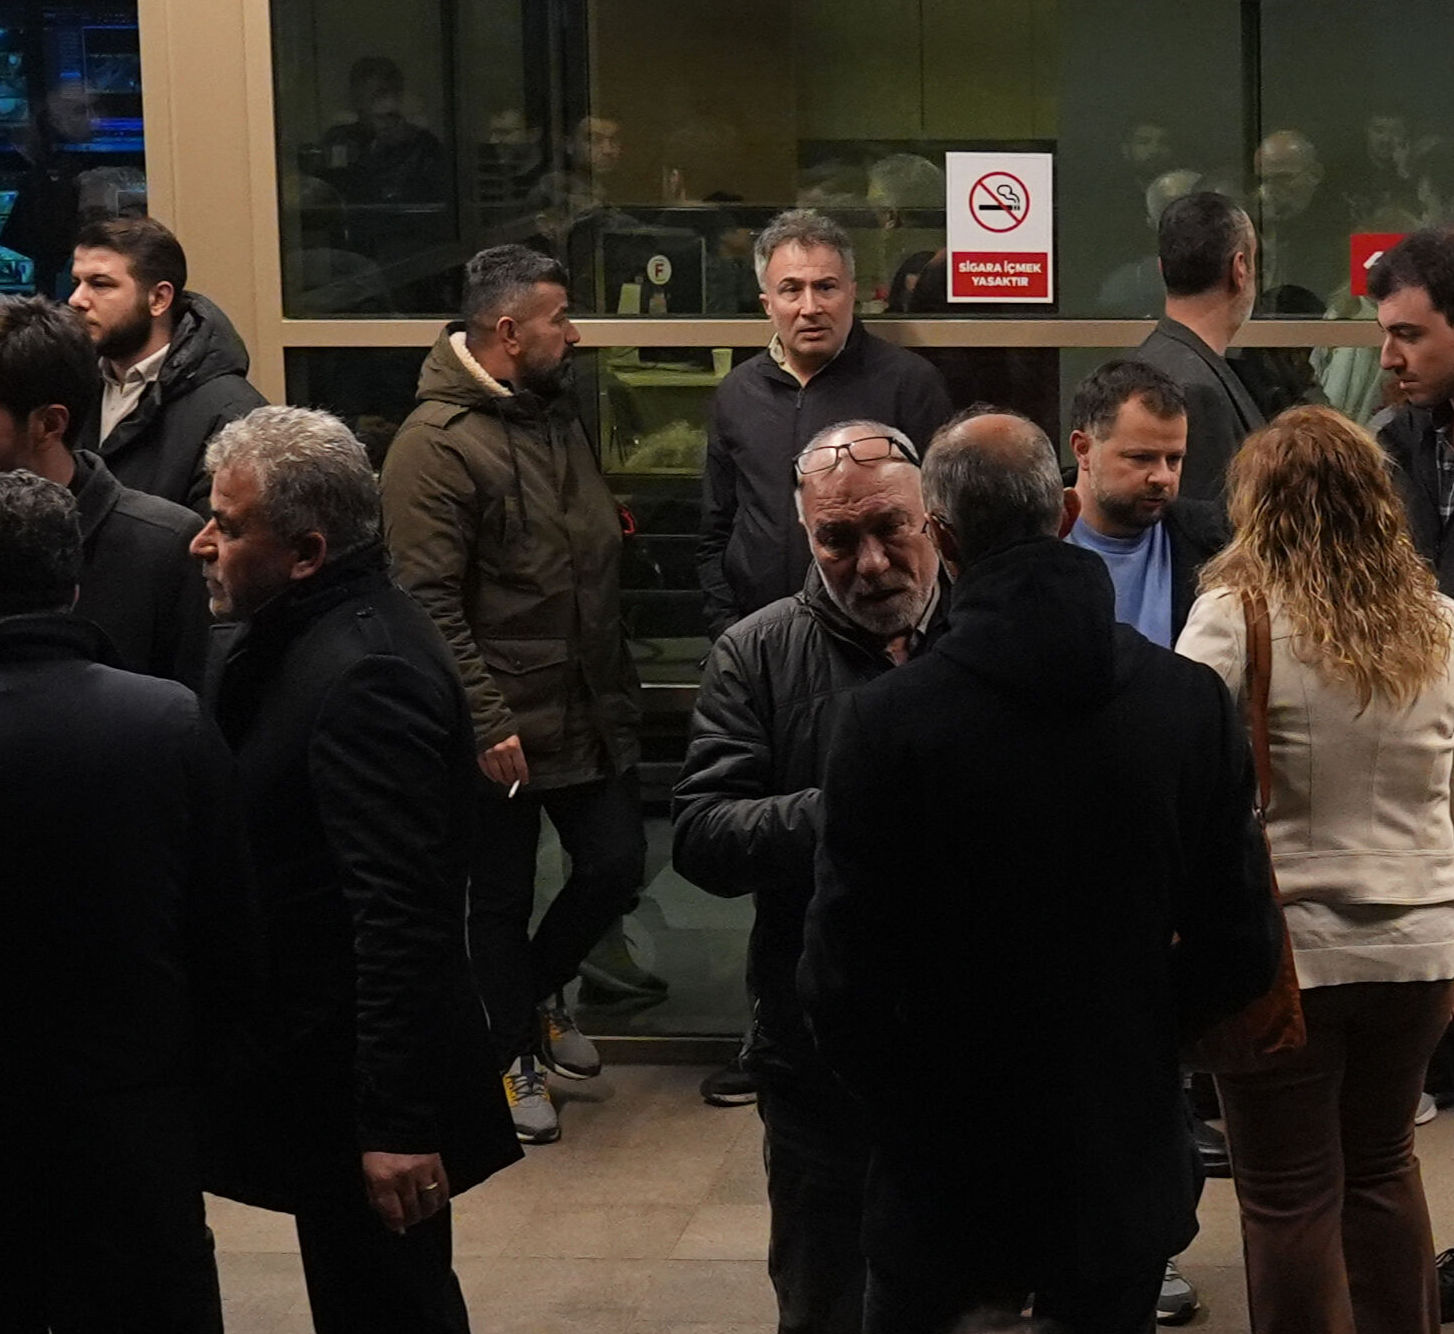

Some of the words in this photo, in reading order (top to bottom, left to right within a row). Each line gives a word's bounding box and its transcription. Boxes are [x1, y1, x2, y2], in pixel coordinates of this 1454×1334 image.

[958, 260, 1003, 273] SİGARA
[1004, 260, 1042, 275] İÇMEK
[971, 276, 1029, 287] YASAKTIR
